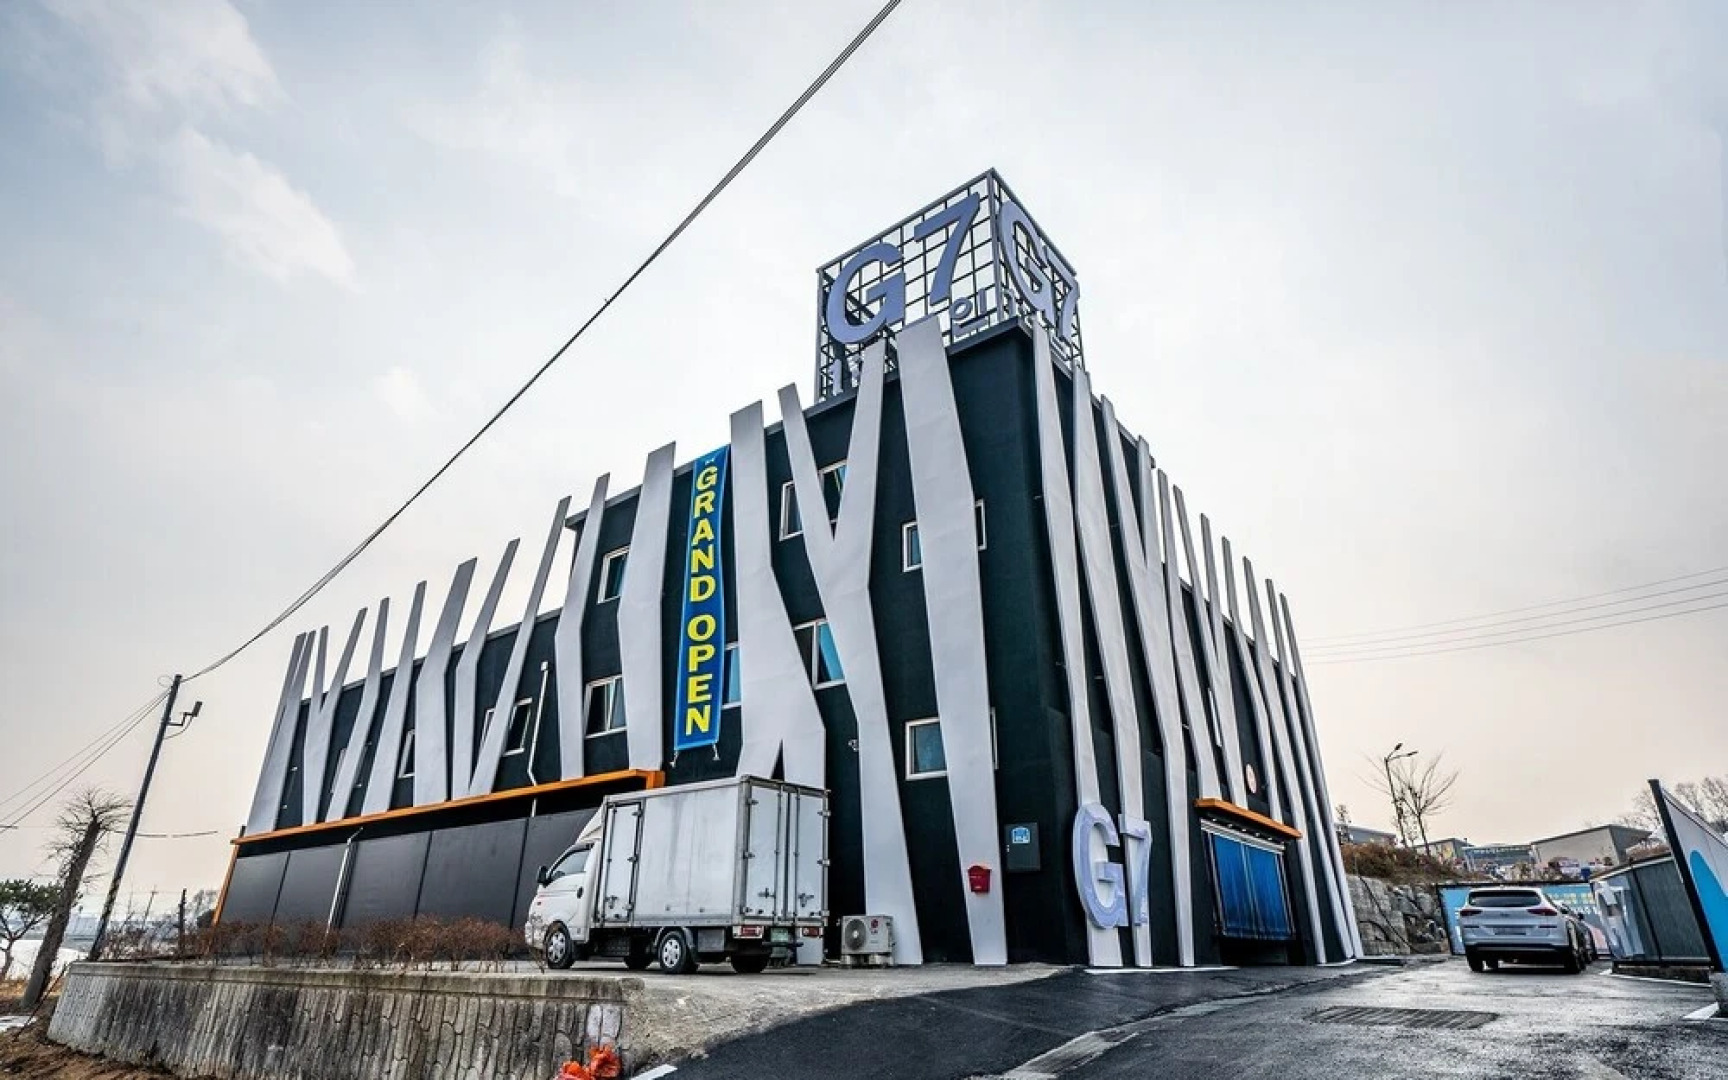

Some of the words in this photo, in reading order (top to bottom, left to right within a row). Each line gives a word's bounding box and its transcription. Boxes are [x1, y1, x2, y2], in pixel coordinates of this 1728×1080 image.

[827, 192, 979, 343] G7
[1001, 199, 1080, 345] G7
[689, 466, 718, 602] GRAND
[685, 614, 716, 736] OPEN
[1073, 801, 1152, 928] G7
